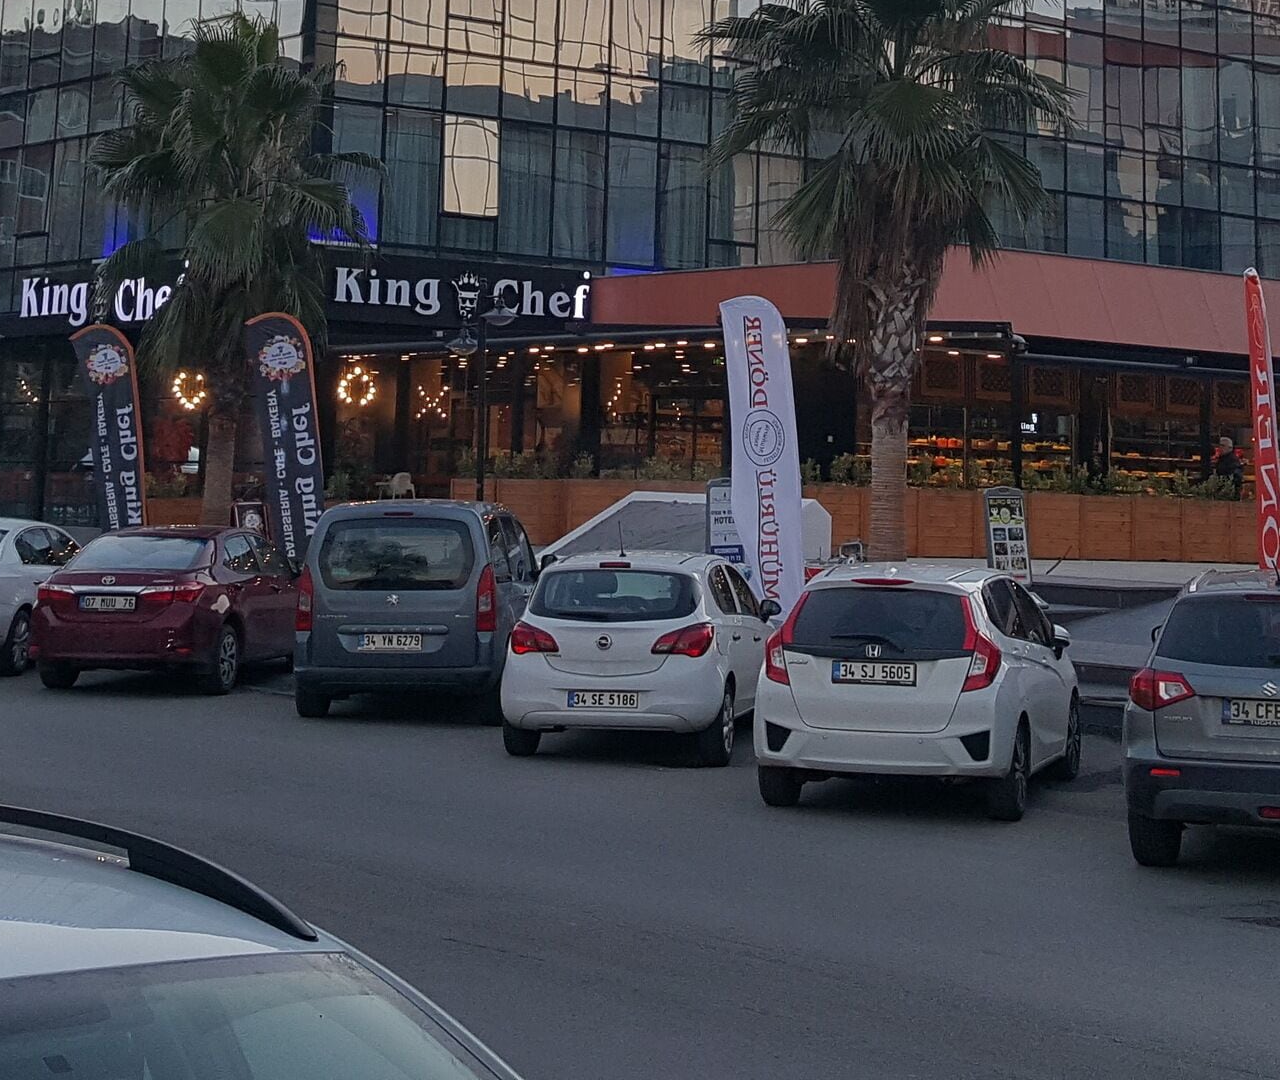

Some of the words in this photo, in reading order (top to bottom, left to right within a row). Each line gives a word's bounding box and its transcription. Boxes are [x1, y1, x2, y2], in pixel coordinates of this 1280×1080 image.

[19, 276, 89, 327] King
[114, 273, 186, 322] Che
[334, 266, 441, 316] King
[493, 272, 591, 319] Chef
[85, 597, 96, 607] 07
[123, 598, 134, 607] 76
[364, 635, 376, 646] 34
[382, 635, 393, 646] YN
[396, 636, 420, 646] 6279
[841, 664, 855, 677] 34
[861, 664, 875, 678] SJ
[881, 665, 911, 680] 5605
[575, 693, 587, 705] 34
[591, 694, 604, 705] SE
[608, 694, 635, 706] 5186
[1231, 701, 1250, 718] 34
